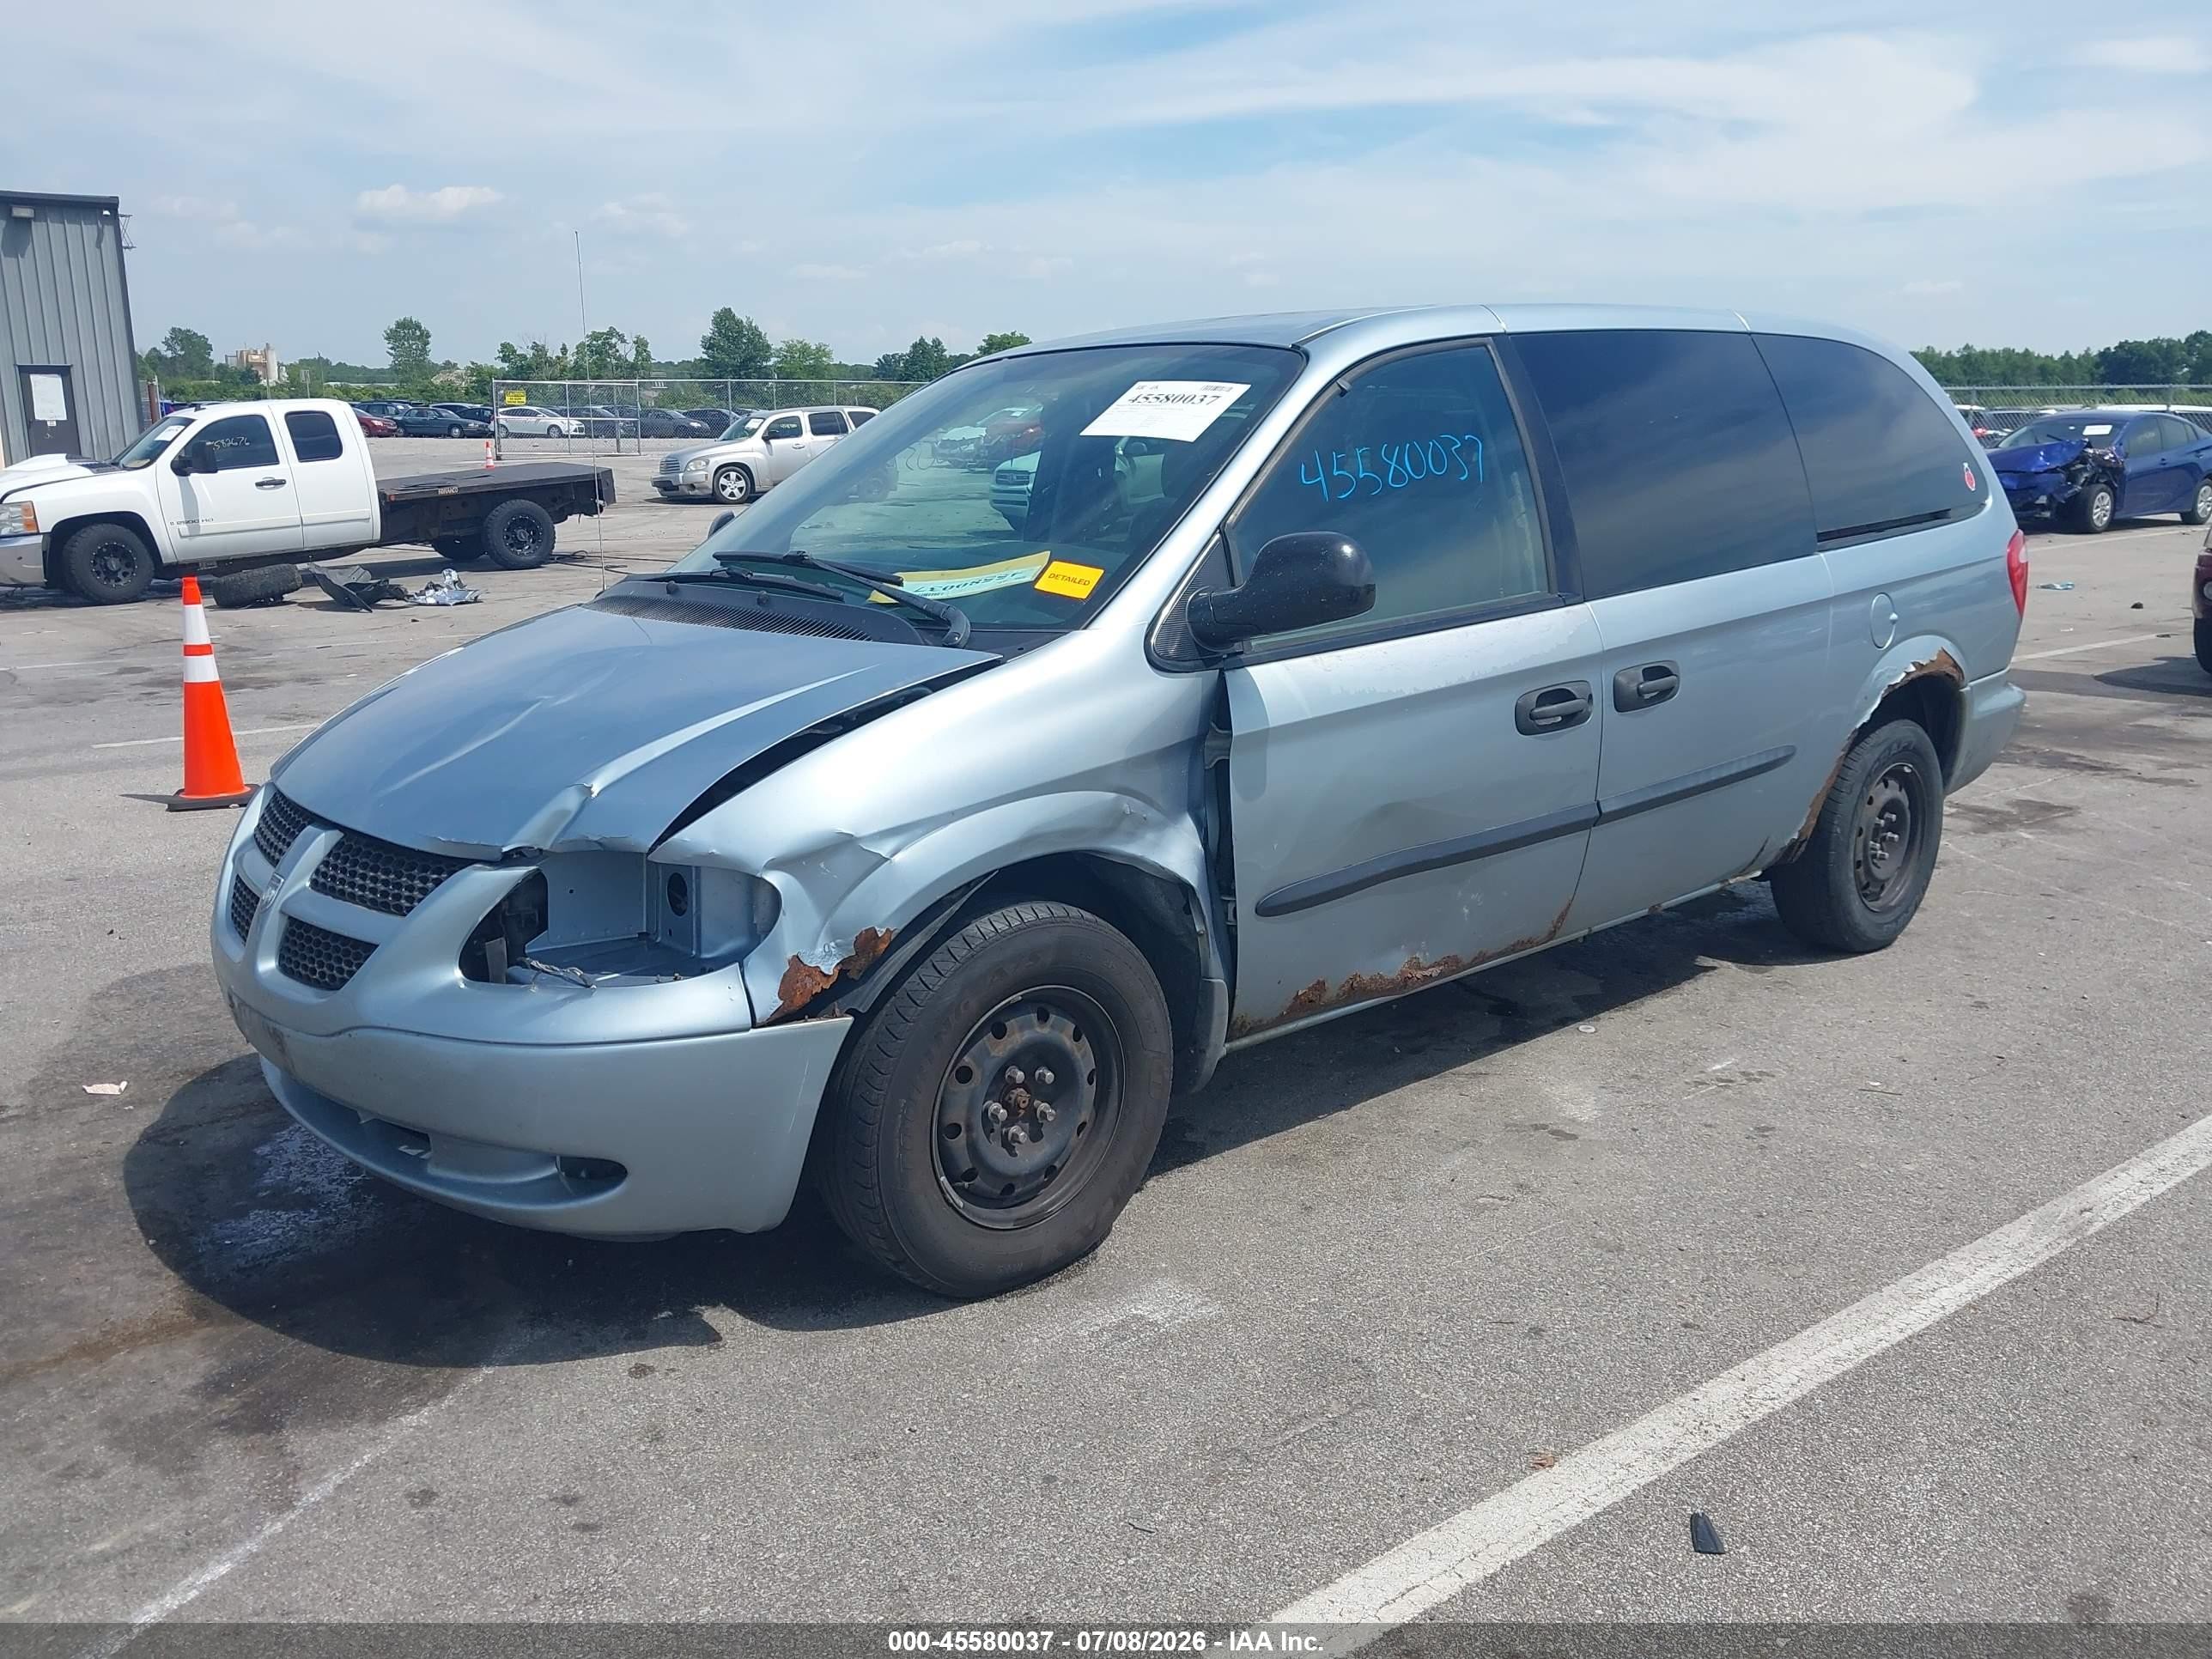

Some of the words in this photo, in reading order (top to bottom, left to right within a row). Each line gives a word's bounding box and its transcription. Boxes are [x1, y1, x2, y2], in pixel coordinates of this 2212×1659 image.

[1128, 393, 1222, 405] 45580037
[1301, 434, 1483, 501] 45580037
[1048, 573, 1091, 586] DETAILED
